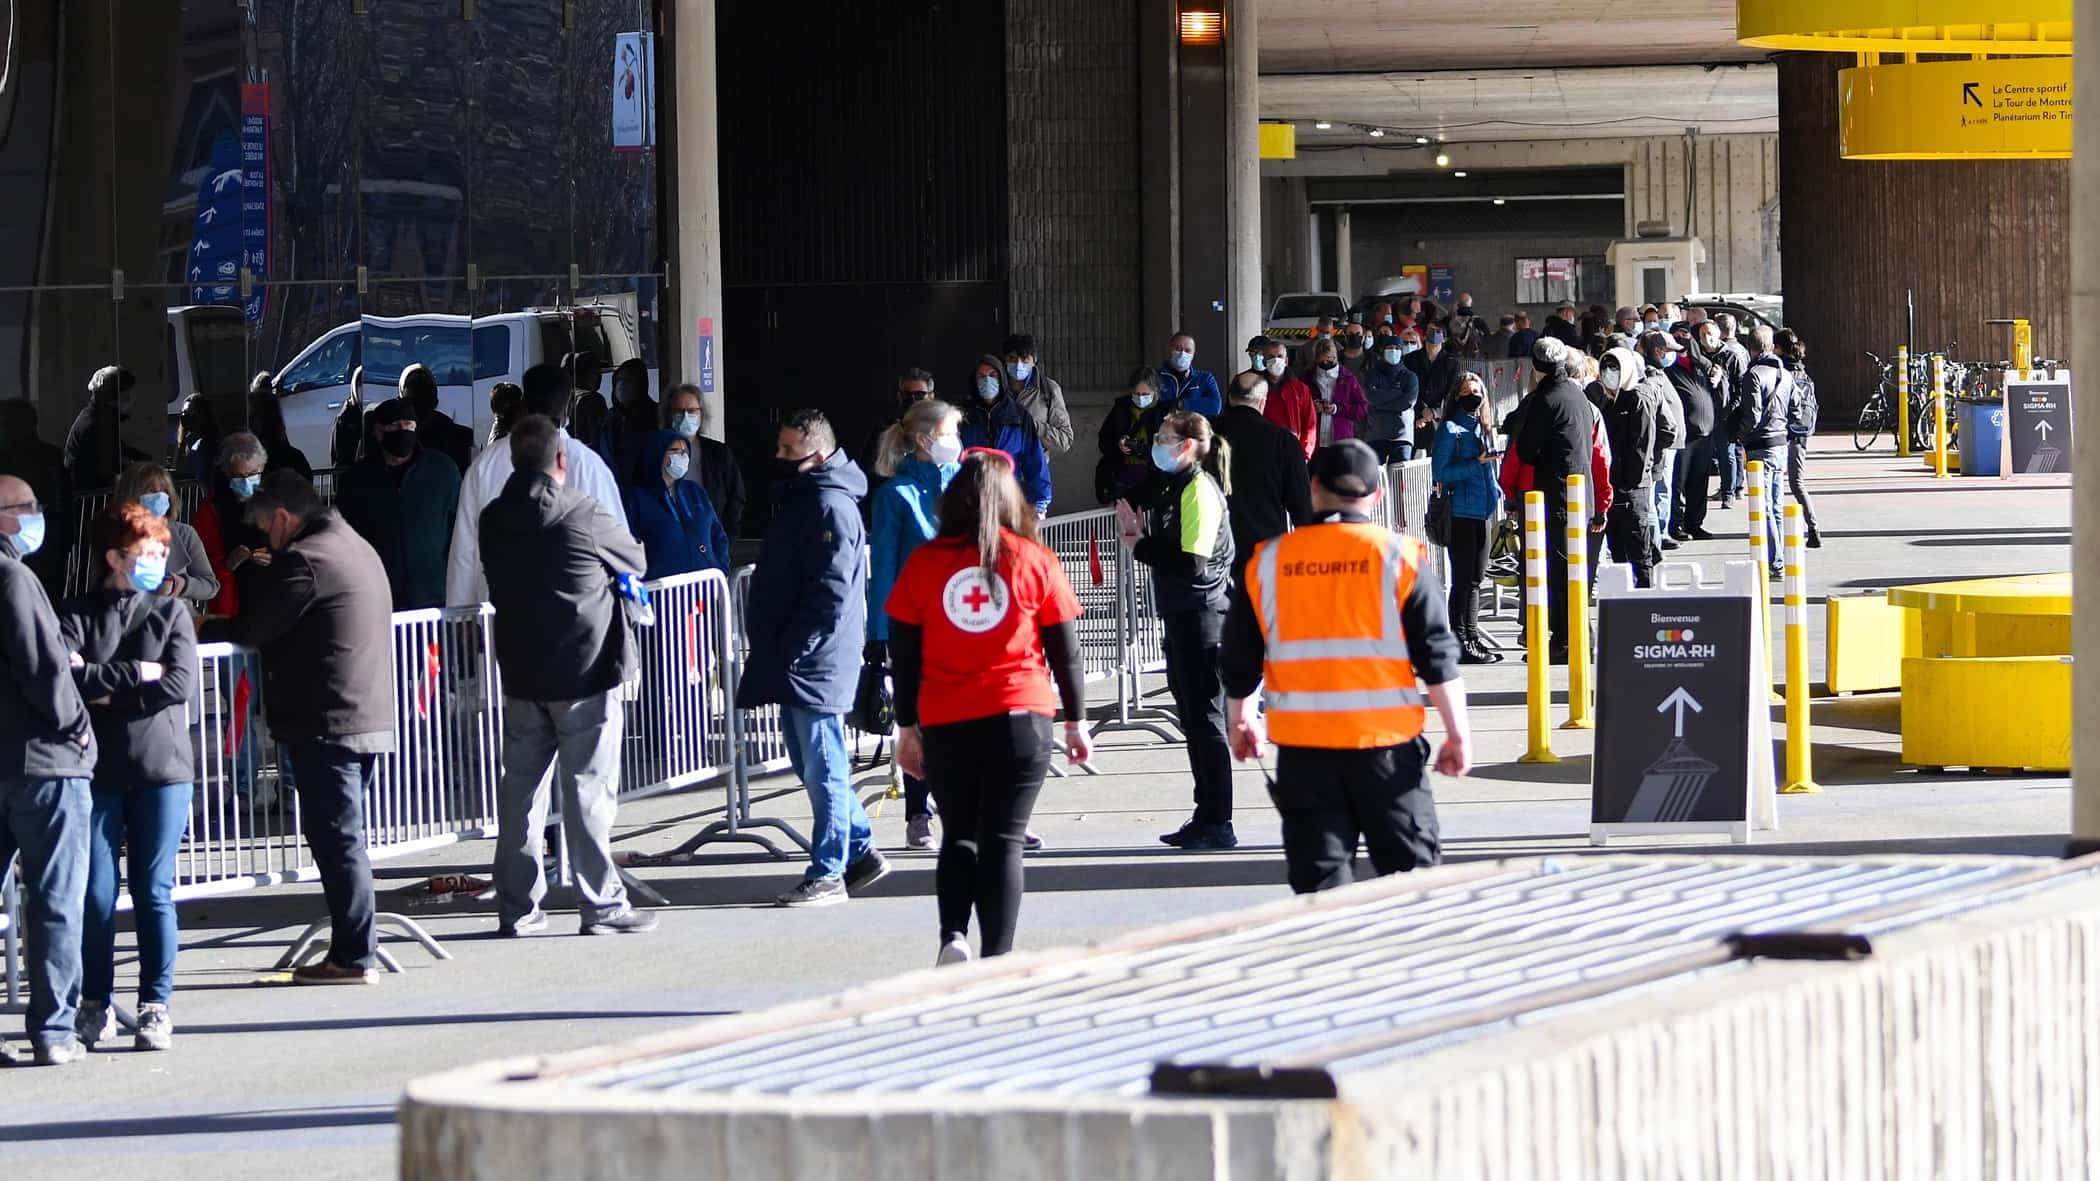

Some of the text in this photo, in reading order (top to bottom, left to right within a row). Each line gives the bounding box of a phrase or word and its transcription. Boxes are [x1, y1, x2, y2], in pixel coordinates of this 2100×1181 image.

[1993, 83, 2068, 95] Le Centre sportif
[1993, 99, 2003, 108] La
[2005, 98, 2023, 107] Tour
[2026, 97, 2037, 107] de
[1993, 112, 2040, 121] Planétarium
[2042, 111, 2057, 120] Rio
[1282, 557, 1369, 577] SÉCURITÉ
[1650, 612, 1701, 624] Bienvenue
[1633, 644, 1716, 659] SIGMA-RH
